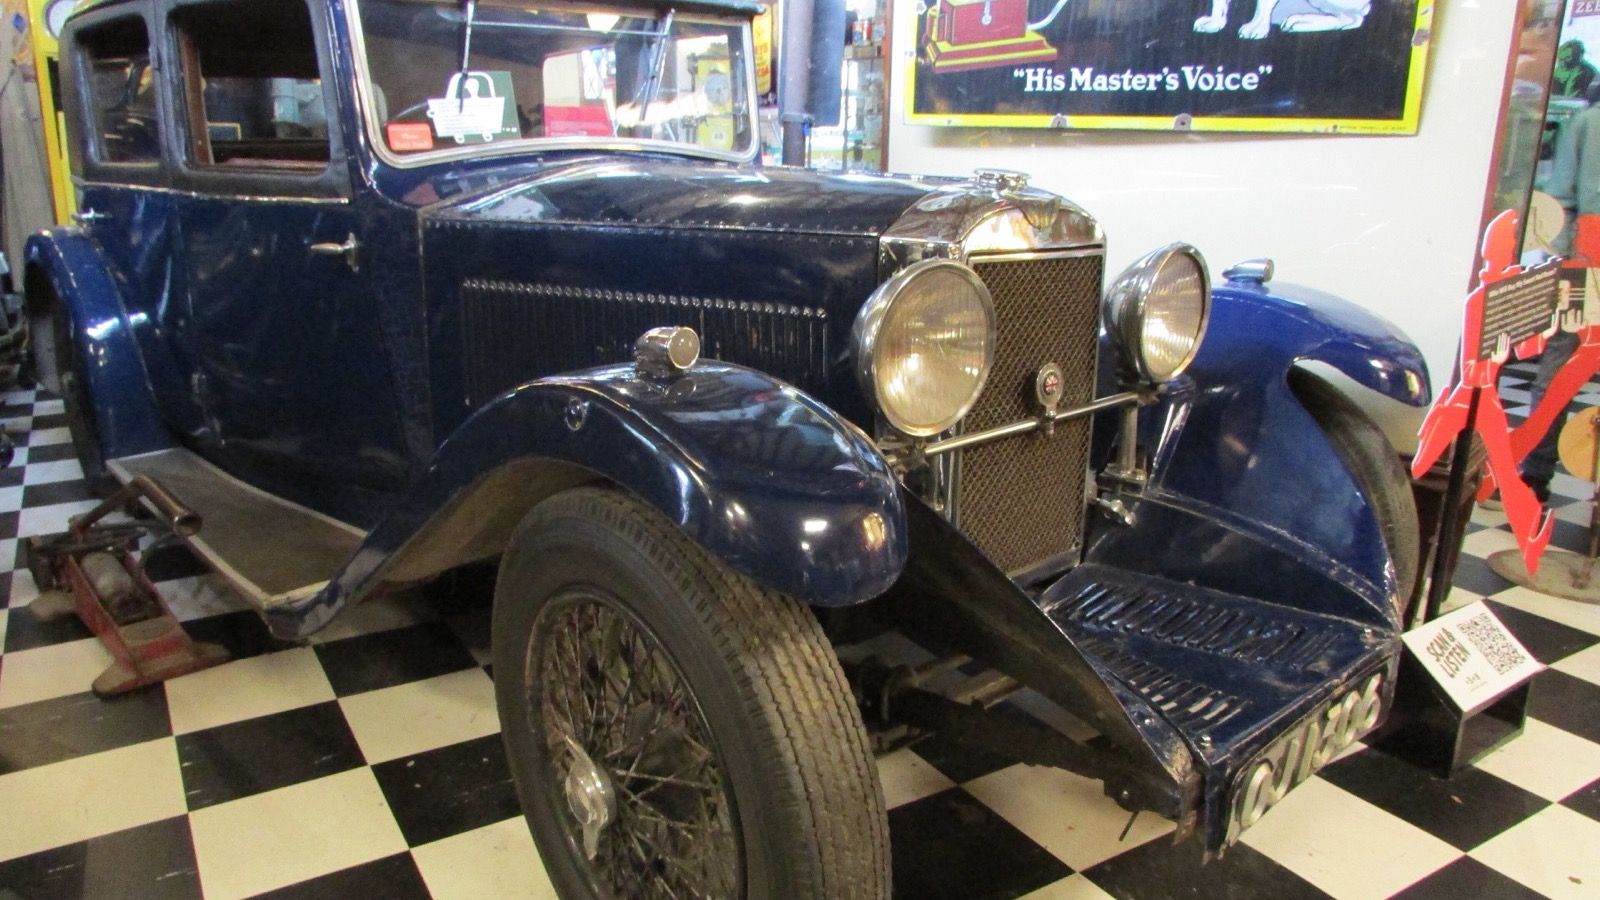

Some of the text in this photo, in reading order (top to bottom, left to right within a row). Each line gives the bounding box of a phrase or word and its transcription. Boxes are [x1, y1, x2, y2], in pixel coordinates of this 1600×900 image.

[1013, 64, 1273, 92] "His Master's Voice"
[1426, 632, 1451, 662] SCAN
[1440, 641, 1471, 678] LISTEN
